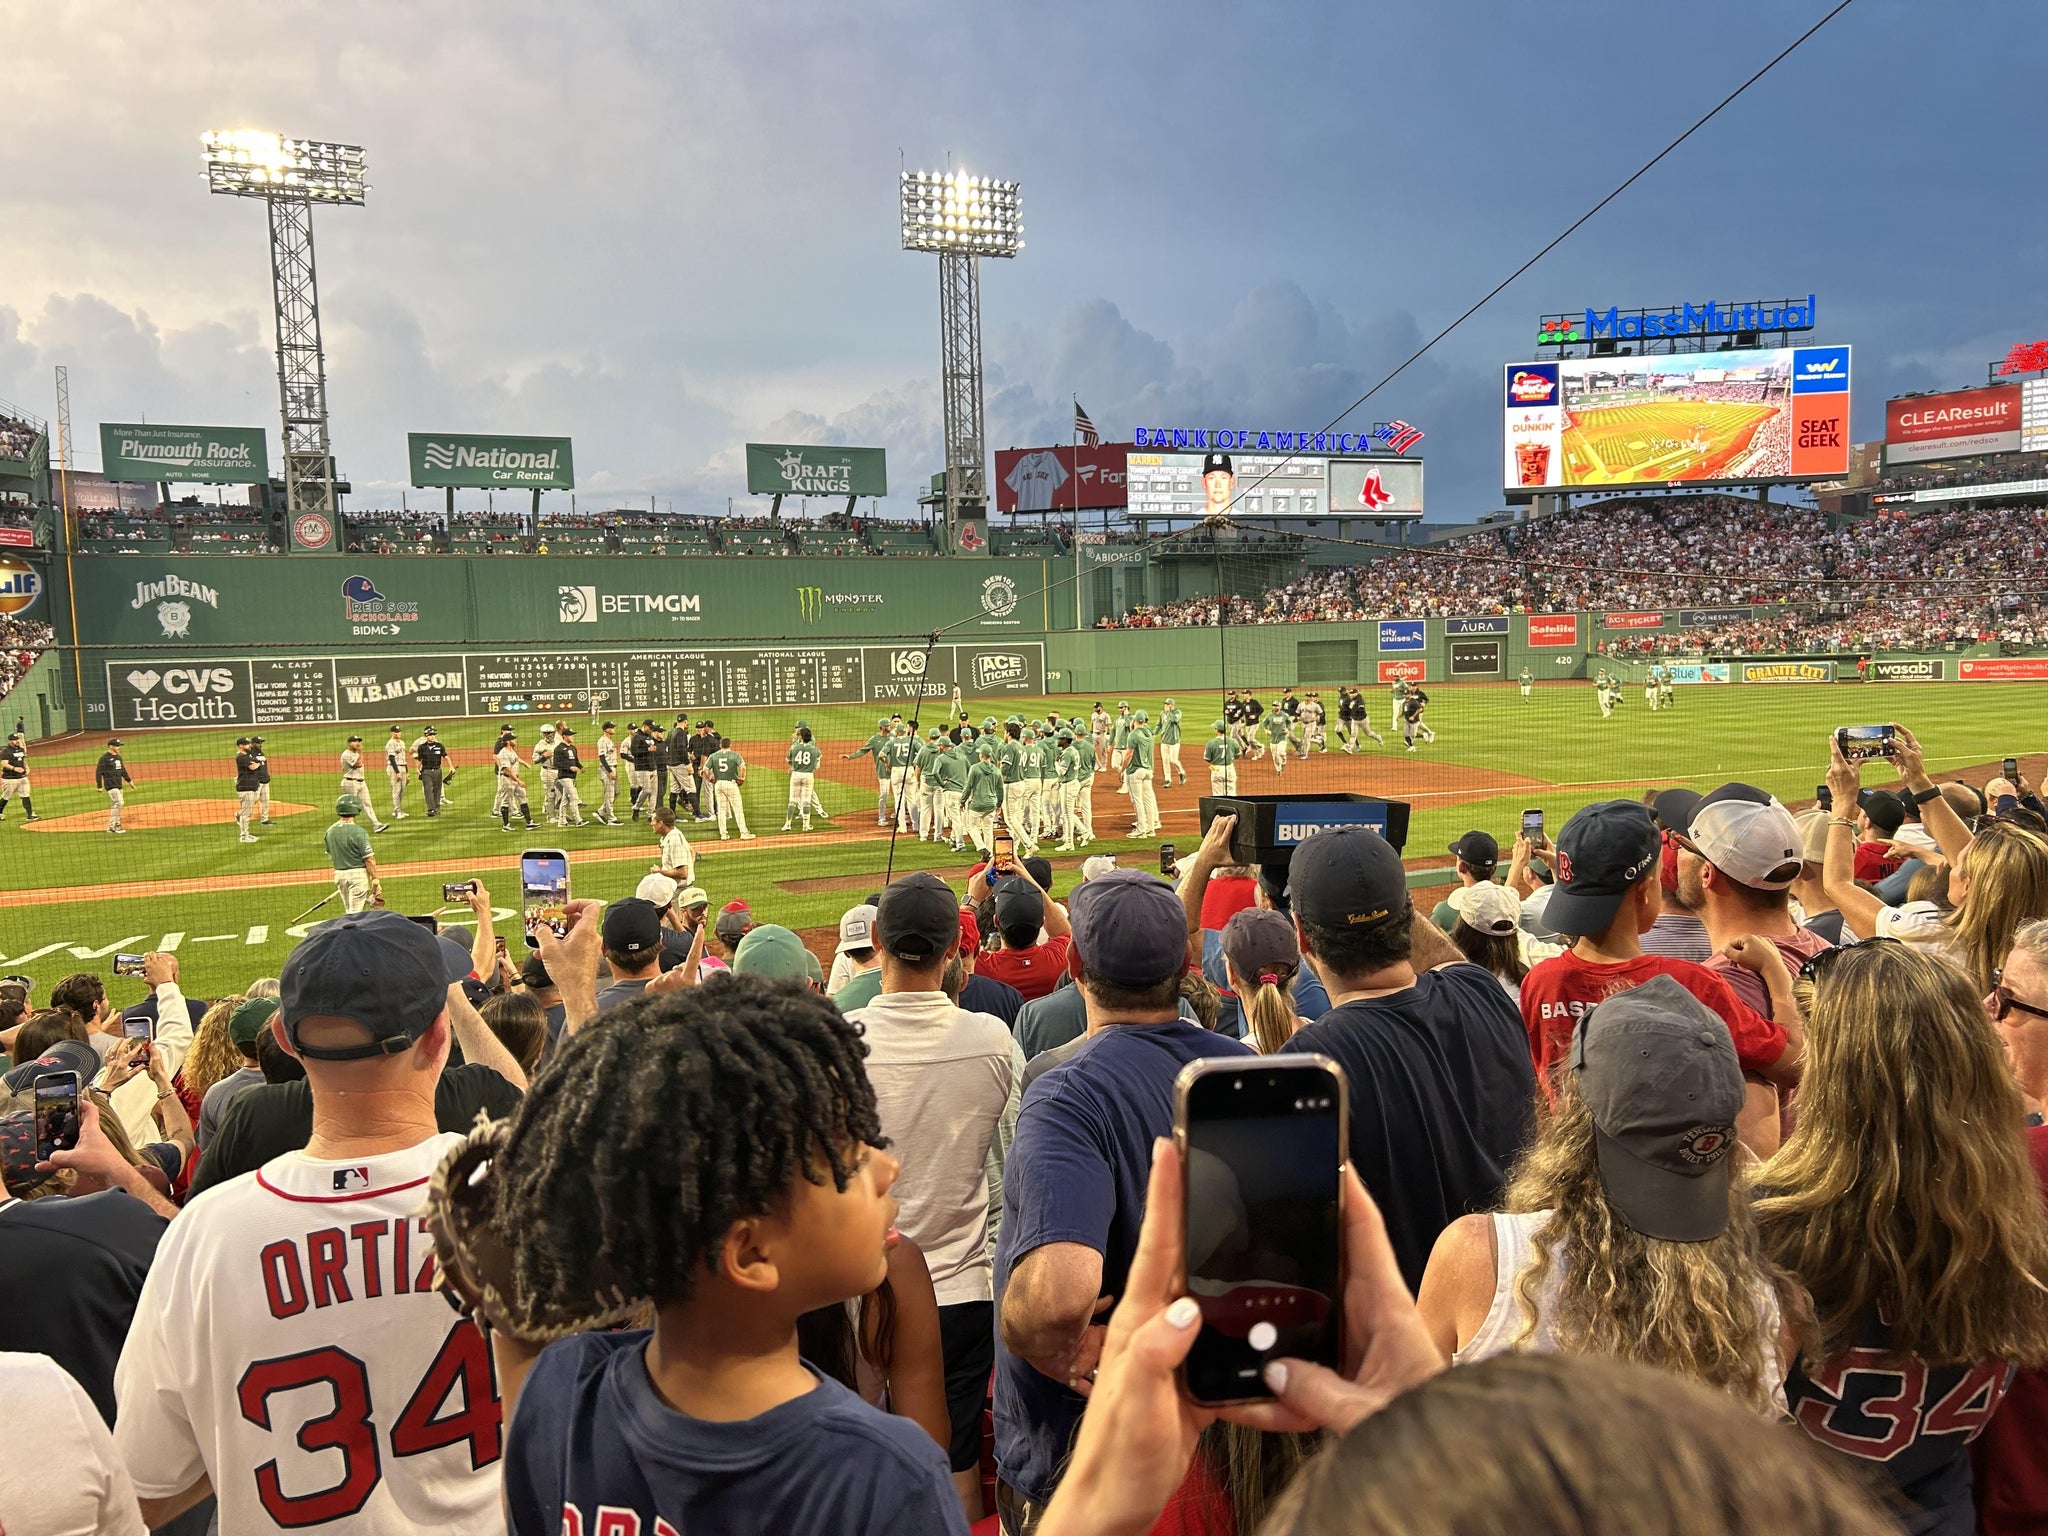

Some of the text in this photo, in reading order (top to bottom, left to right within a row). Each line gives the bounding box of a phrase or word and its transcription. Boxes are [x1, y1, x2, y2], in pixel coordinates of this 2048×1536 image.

[1585, 294, 1815, 339] MassMutual
[1900, 402, 2008, 427] CLEAResult
[1800, 418, 1839, 433] SEAT
[113, 429, 133, 437] More
[1134, 427, 1371, 452] BANK OF AMERICA
[1798, 433, 1840, 448] GEEK
[1909, 437, 1999, 453] clearesult.com/redsox
[121, 440, 250, 461] Plymouth Rock
[456, 446, 559, 469] National
[194, 459, 252, 468] assurance
[492, 470, 554, 480] Car Rental
[781, 463, 851, 479] DRAFT
[1036, 471, 1049, 480] SOX
[790, 479, 851, 493] KINGS
[74, 493, 97, 502] Your
[1250, 498, 1313, 512] 4 2 2
[1095, 553, 1142, 562] ABIOMED
[982, 575, 1015, 589] IBEW 103
[601, 594, 700, 613] BETMGM
[825, 593, 884, 604] MONSTER
[352, 602, 418, 612] RED SOX
[171, 612, 178, 621] B
[352, 613, 419, 622] SCHOLARS
[1629, 615, 1662, 626] TICKET
[352, 626, 389, 636] BIDMC
[1381, 629, 1397, 637] city
[1530, 625, 1575, 634] Safelite
[890, 651, 927, 675] 160
[982, 655, 1021, 671] ACE
[1555, 656, 1572, 665] 420
[1877, 660, 1934, 675] wasabi
[985, 669, 1022, 682] TICKET
[1047, 672, 1061, 680] 379
[1386, 667, 1419, 677] IRVING
[1746, 665, 1797, 680] GRANITE
[1800, 664, 1827, 680] CITY
[162, 668, 234, 693] CVS
[874, 683, 947, 698] F.W. WEBB
[87, 704, 105, 712] 310
[133, 696, 237, 722] Health
[488, 702, 499, 712] 16
[894, 743, 910, 757] 75
[1219, 745, 1228, 759] 7
[795, 750, 811, 765] 48
[1029, 752, 1041, 768] 91
[718, 758, 728, 772] 5
[1278, 824, 1321, 841] BUD
[1683, 1126, 1721, 1142] FENWAY
[1679, 1148, 1703, 1164] BUILT
[1795, 1348, 2016, 1463] 34
[237, 1317, 502, 1529] 34
